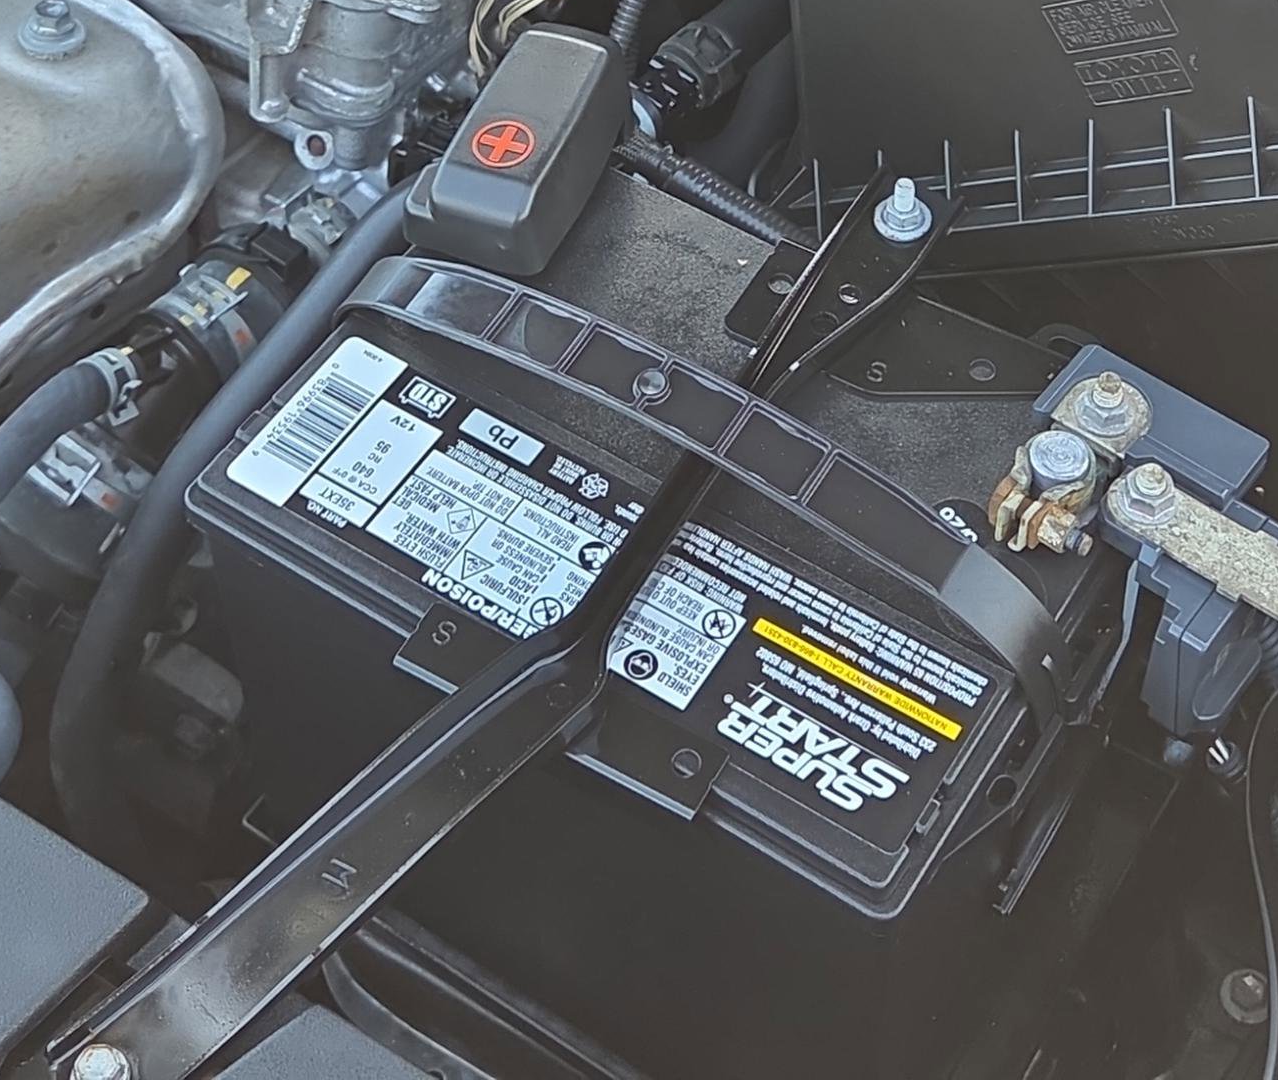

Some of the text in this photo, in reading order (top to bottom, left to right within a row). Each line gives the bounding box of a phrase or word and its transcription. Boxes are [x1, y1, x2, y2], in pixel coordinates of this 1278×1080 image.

[1075, 50, 1181, 82] TOYOTA
[250, 361, 340, 456] 0 83996 19534 9
[406, 381, 449, 411] STD
[389, 413, 417, 432] 12V
[373, 439, 392, 454] 95
[483, 423, 519, 449] Pb
[350, 460, 375, 478] 640
[366, 451, 382, 463] RC
[355, 479, 378, 495] CCA
[484, 468, 499, 480] OR
[504, 466, 544, 492] CHARGING
[317, 485, 356, 511] 35EXT
[391, 494, 412, 510] GET
[398, 485, 441, 513] MEDICAL
[406, 476, 457, 509] HELP FAST.
[423, 465, 509, 516] DO NOT OPEN BATTERY.
[470, 479, 515, 507] DO NOT TIP.
[495, 474, 548, 506] DISASSEMBLE
[540, 485, 573, 508] PROPER
[303, 499, 348, 528] PART NO.
[543, 499, 563, 514] NOT
[559, 508, 575, 521] DO
[569, 501, 604, 524] FOLLOW
[401, 511, 462, 549] WITH WATER.
[519, 506, 580, 543] INSTRUCTIONS.
[571, 514, 603, 535] BURNS.
[599, 529, 615, 542] OR
[391, 533, 447, 568] FLUSH EYES
[392, 519, 454, 559] IMMEDIATELY
[493, 526, 555, 564] SEVERE BURNS.
[534, 526, 573, 551] READ ALL
[490, 538, 548, 574] BLINDNESS OR
[495, 554, 540, 583] CAN CAUSE
[507, 574, 533, 593] ACID
[671, 568, 687, 582] OF
[683, 575, 706, 592] RISK
[478, 573, 525, 604] SULFURIC
[662, 584, 705, 611] REACH OF
[702, 585, 745, 613] WARNING:
[728, 587, 748, 603] NOT
[657, 594, 699, 620] KEEP OUT
[668, 632, 697, 652] CAUSE
[674, 624, 721, 654] OR INJURY.
[653, 638, 708, 674] EXPLOSIVE
[695, 647, 715, 662] CAN
[821, 657, 845, 674] CALL
[835, 643, 859, 662] label
[855, 654, 875, 670] this
[656, 671, 693, 696] SHIELD
[669, 662, 700, 685] EYES.
[844, 669, 894, 700] WARRANTY
[879, 667, 900, 684] void
[897, 676, 938, 704] Warranty
[893, 696, 948, 730] NATIONWIDE
[729, 693, 910, 799] START
[714, 710, 873, 810] SUPER
